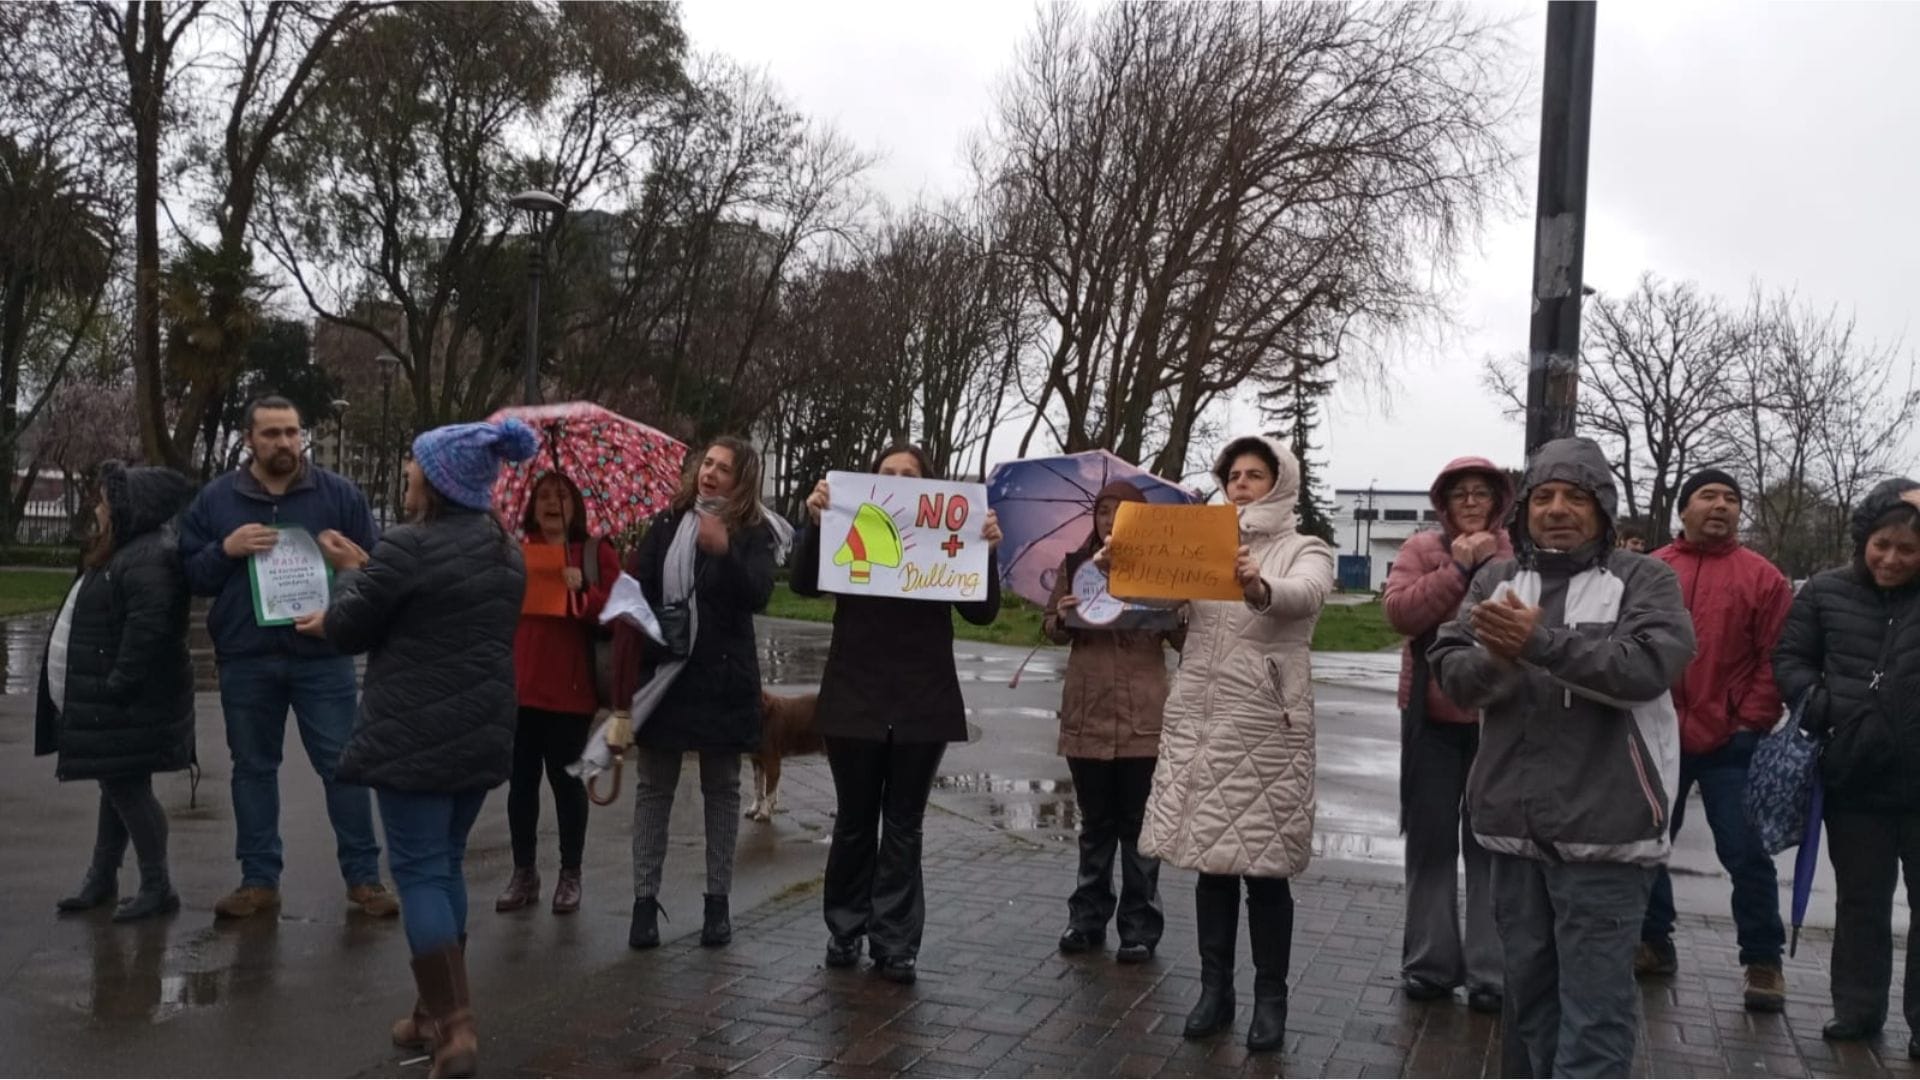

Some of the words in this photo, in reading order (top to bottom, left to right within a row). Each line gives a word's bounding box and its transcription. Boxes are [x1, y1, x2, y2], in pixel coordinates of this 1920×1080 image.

[915, 492, 969, 531] NO
[941, 534, 964, 558] +
[1181, 544, 1208, 562] DE
[899, 561, 981, 597] Bulling
